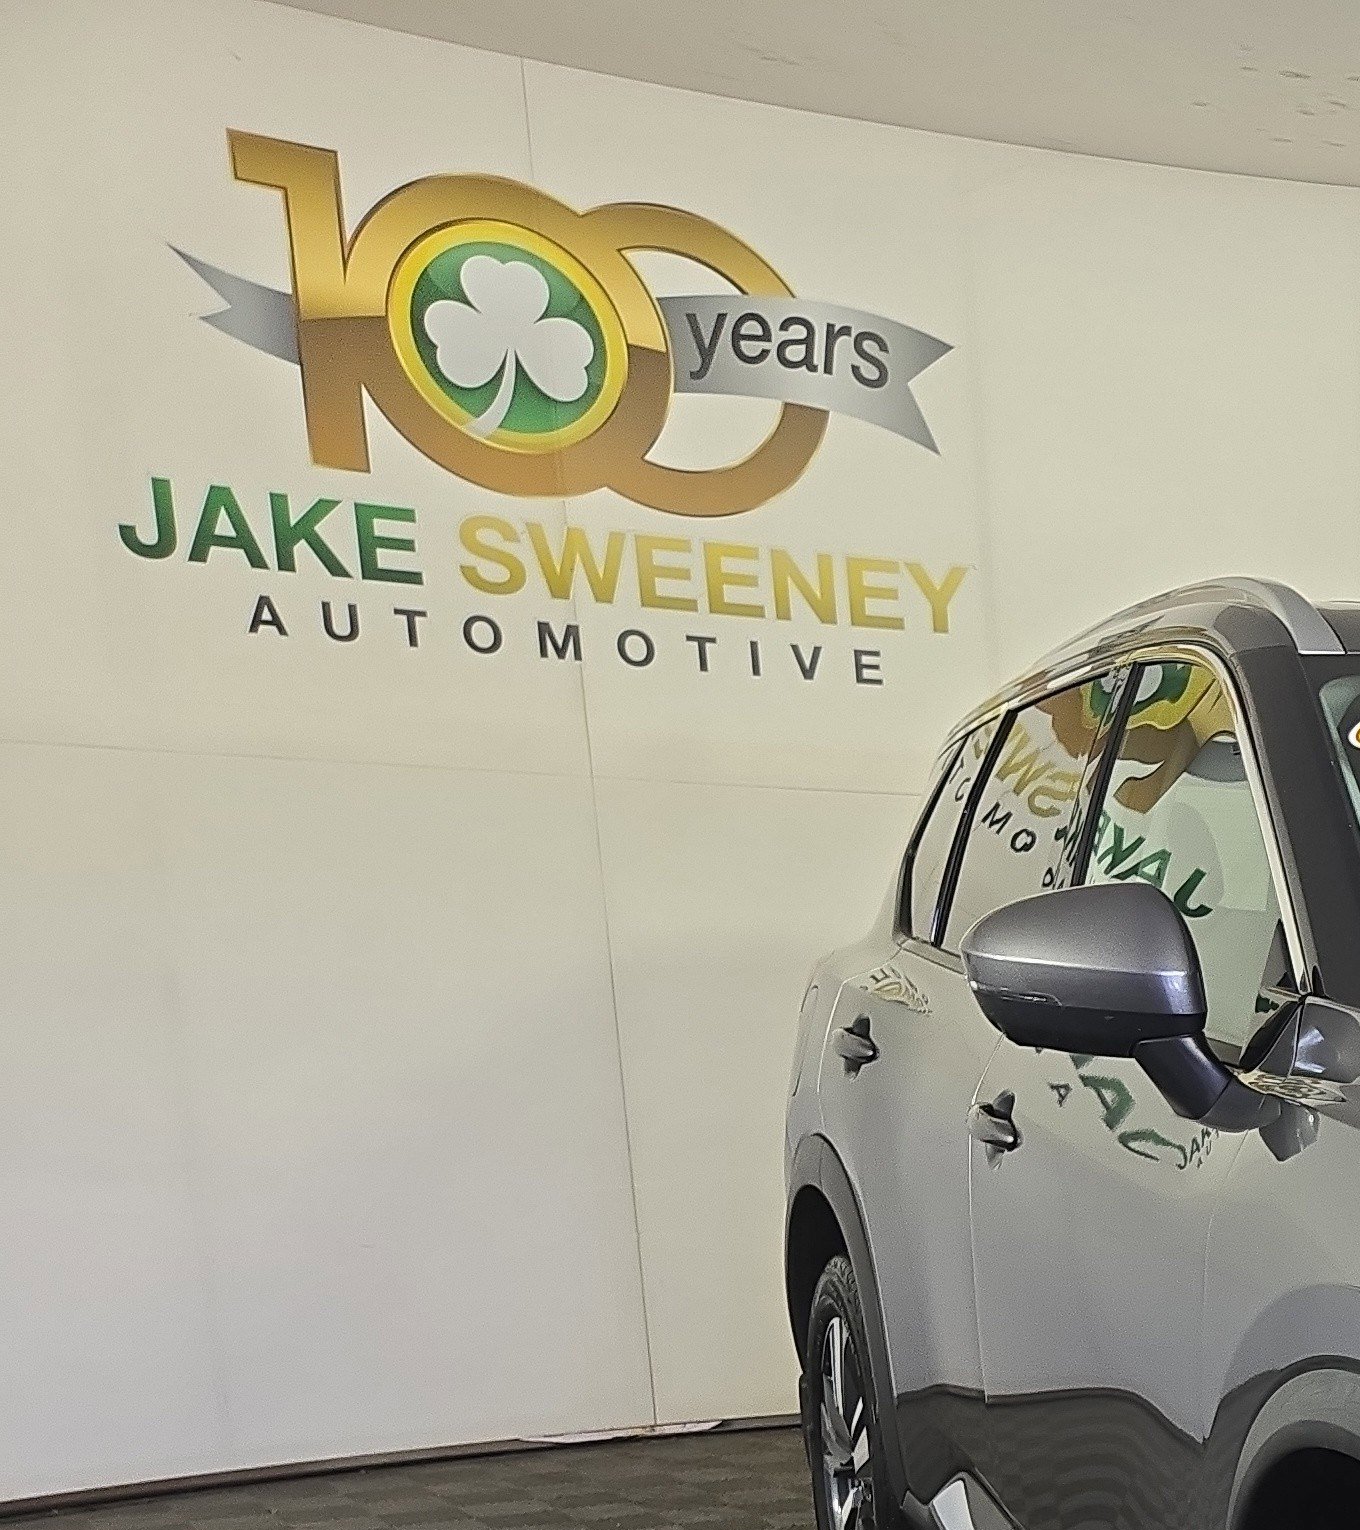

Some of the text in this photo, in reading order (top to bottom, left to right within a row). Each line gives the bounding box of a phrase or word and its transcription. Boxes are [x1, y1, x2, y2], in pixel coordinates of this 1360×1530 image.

[686, 307, 891, 388] years
[118, 478, 969, 634] JAKE SWEENEY
[248, 595, 884, 685] AUTOMOTIVE
